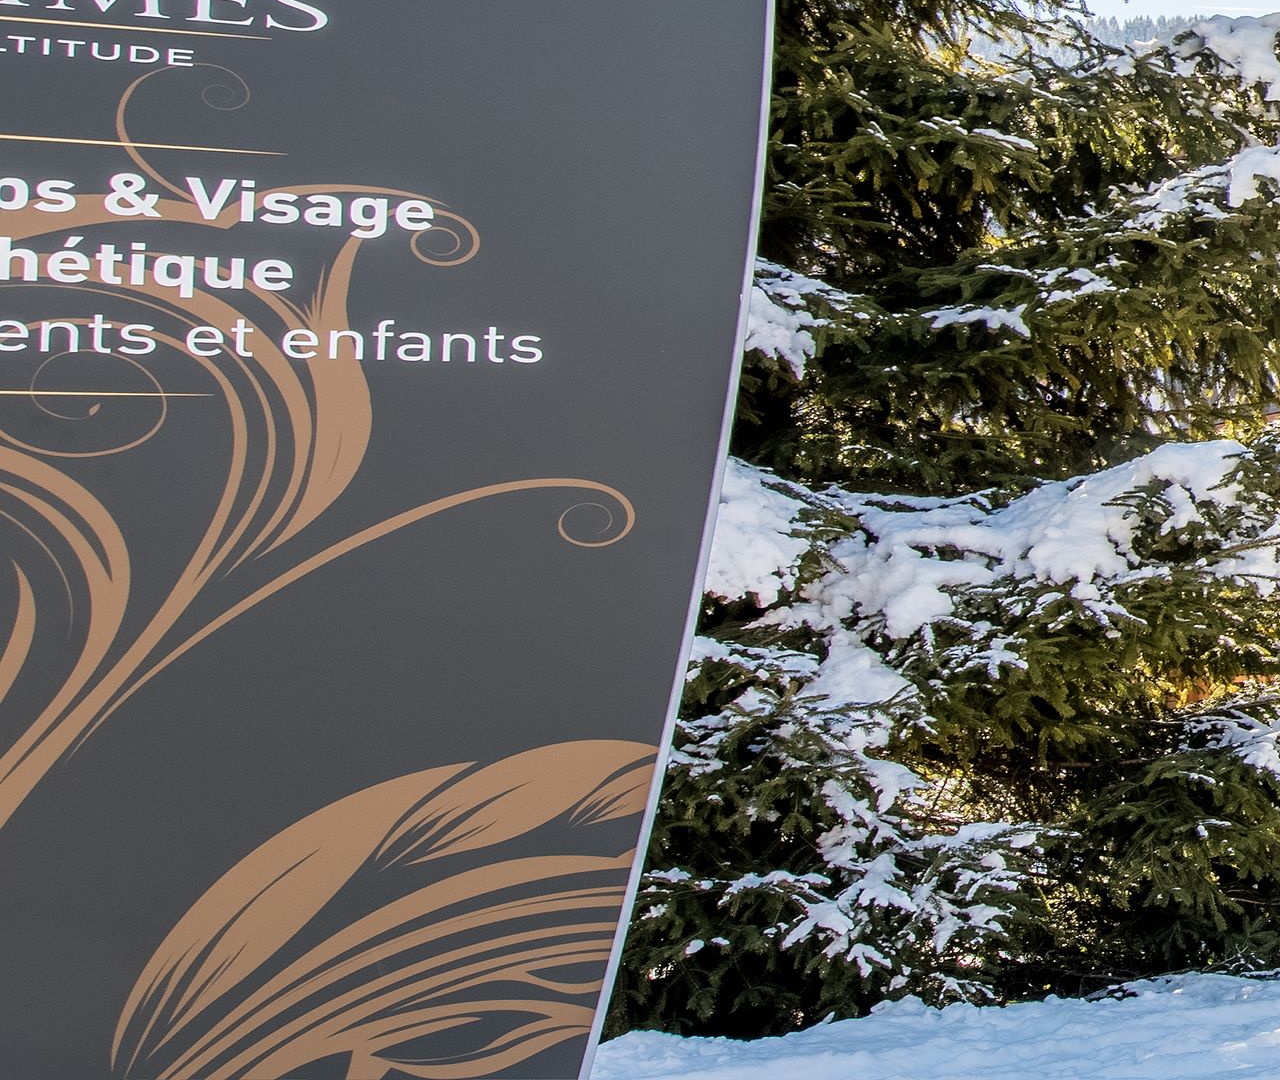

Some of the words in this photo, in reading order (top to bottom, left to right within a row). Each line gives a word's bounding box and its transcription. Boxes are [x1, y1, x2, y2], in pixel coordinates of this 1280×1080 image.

[0, 34, 195, 68] TITUDE
[104, 172, 163, 218] &
[185, 176, 434, 240] Visage
[0, 235, 294, 299] hétique
[0, 313, 157, 356] ents
[185, 318, 255, 358] et
[282, 319, 544, 365] enfants
